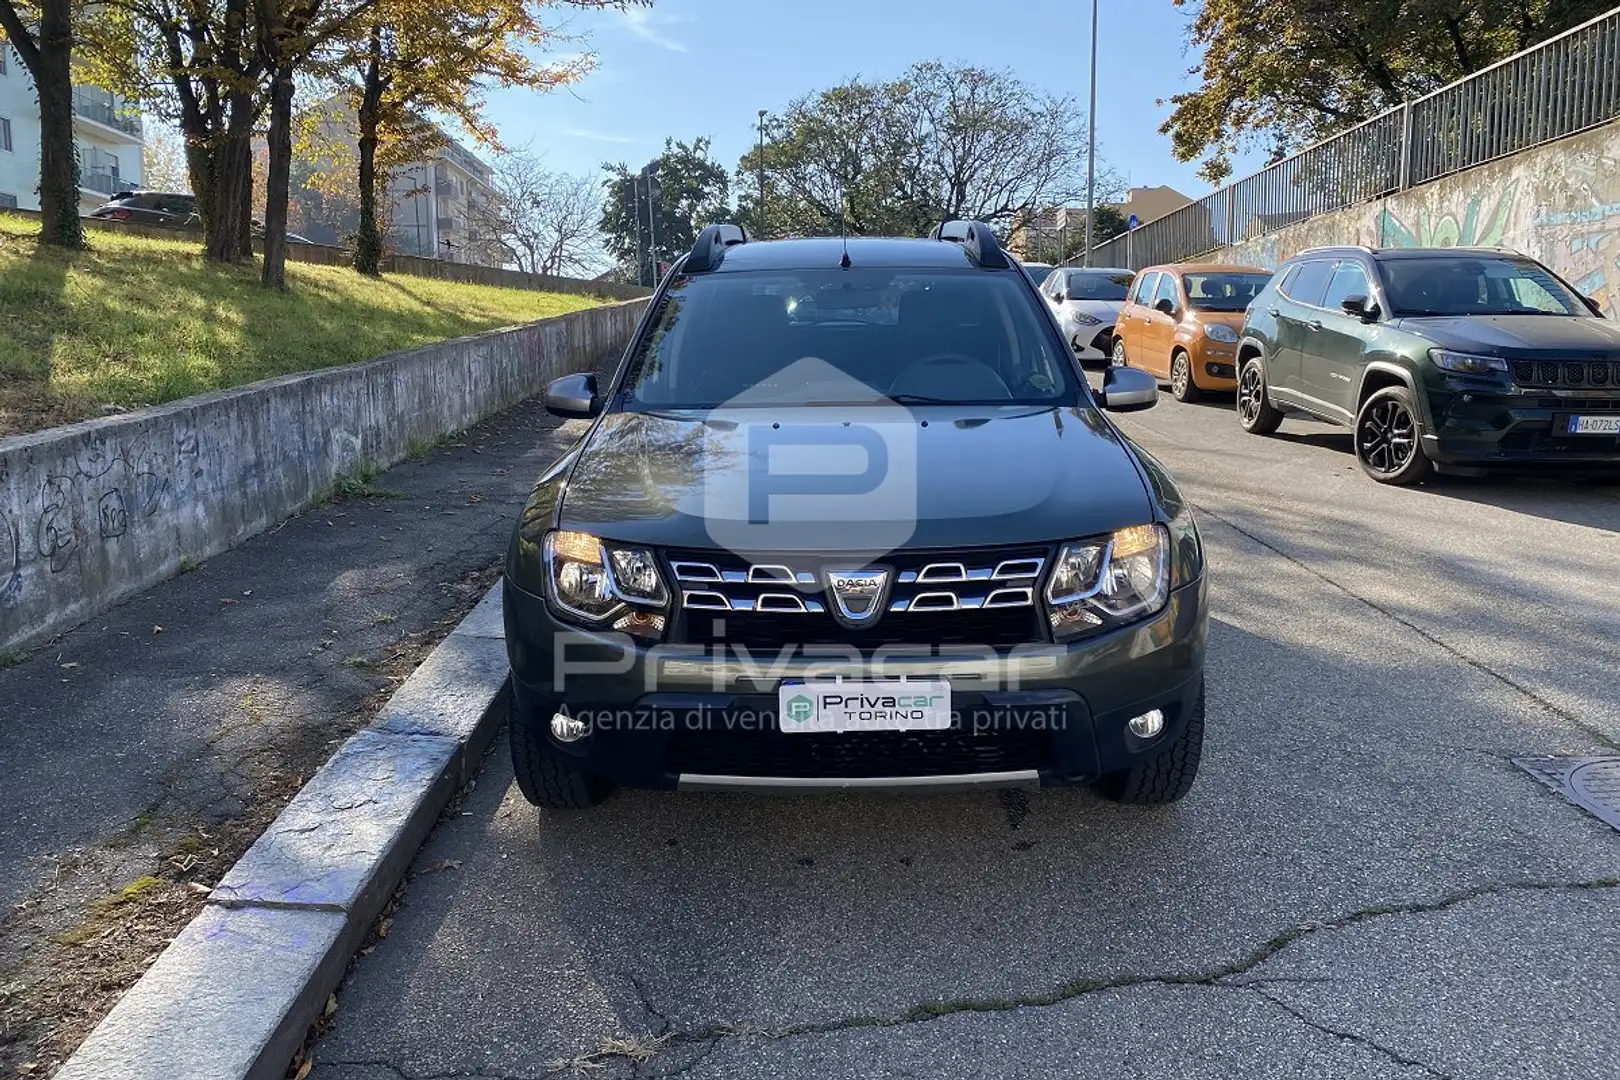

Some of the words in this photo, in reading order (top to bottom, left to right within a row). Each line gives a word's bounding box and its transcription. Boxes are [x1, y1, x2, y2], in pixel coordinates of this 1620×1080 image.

[836, 578, 878, 588] DACIA
[823, 693, 945, 710] Privacar
[844, 710, 924, 721] TORINO
